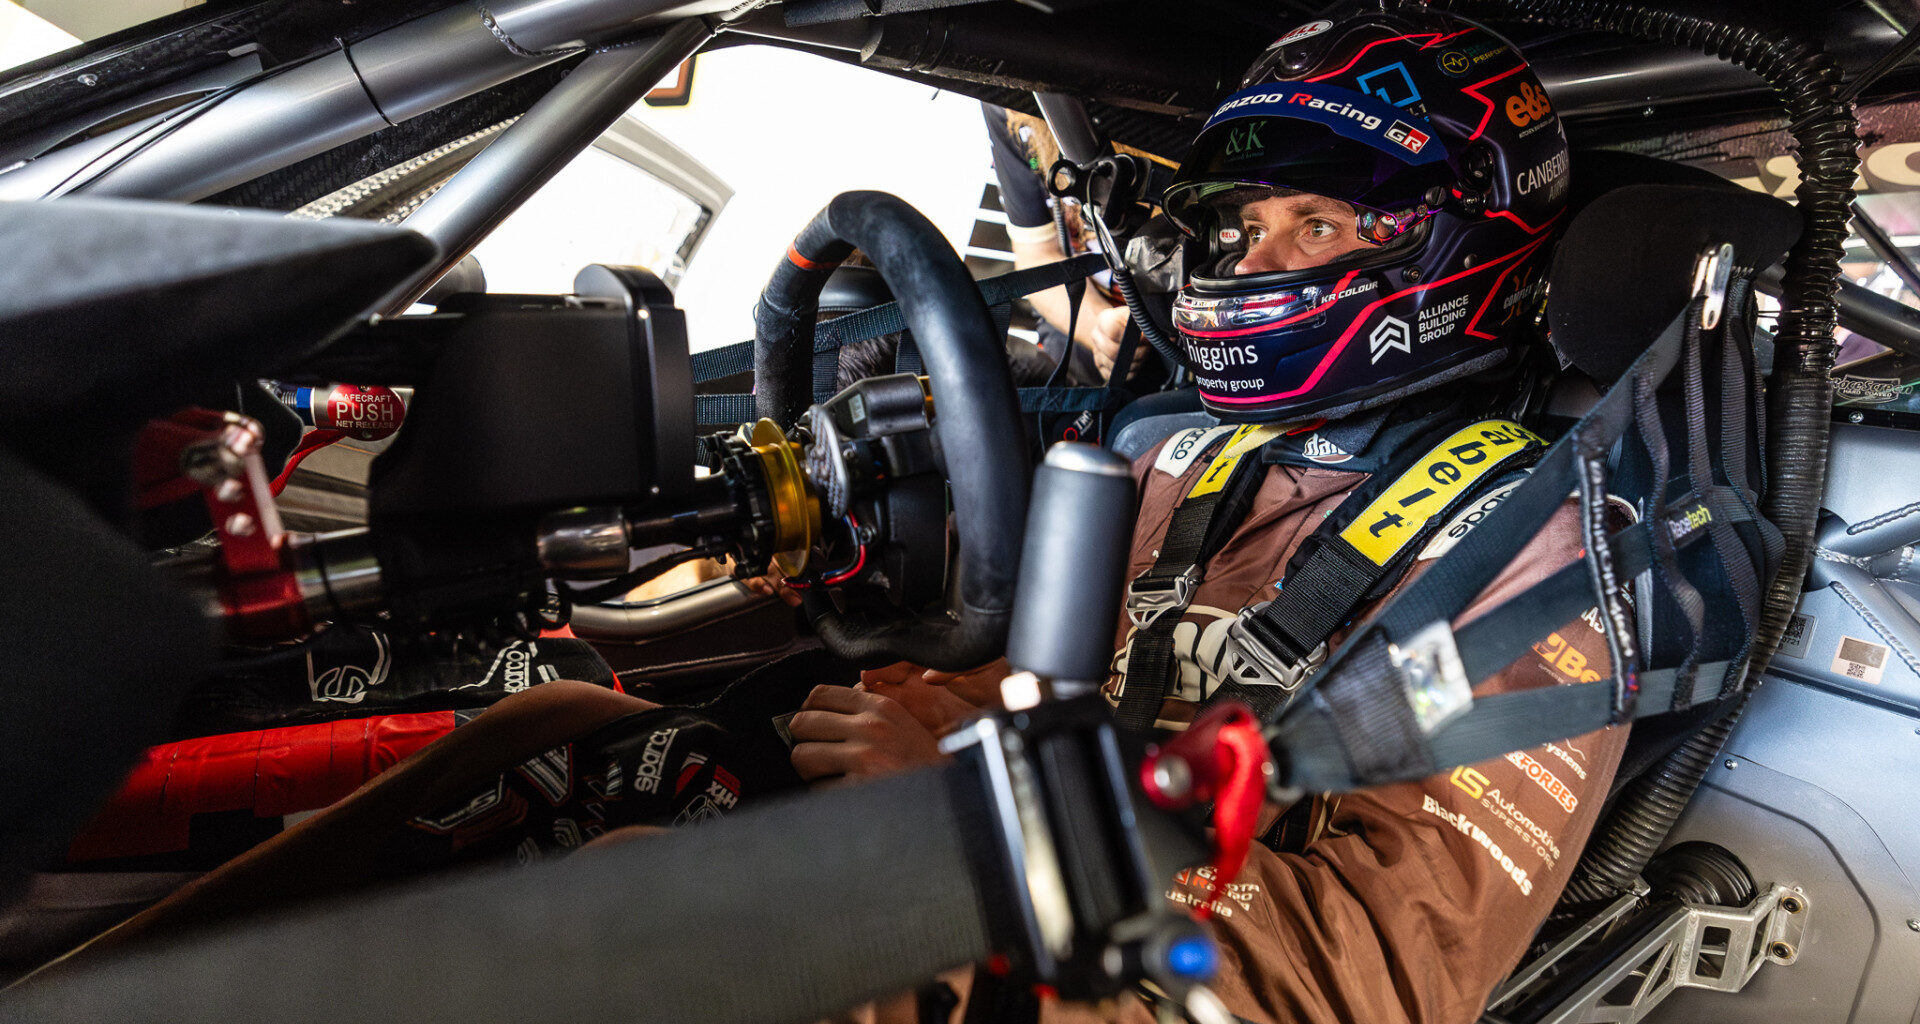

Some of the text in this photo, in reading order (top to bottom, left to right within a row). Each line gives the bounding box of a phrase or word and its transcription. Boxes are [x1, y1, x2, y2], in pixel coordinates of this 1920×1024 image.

[1214, 92, 1383, 132] GAZOO Racing
[1387, 128, 1423, 152] GR
[1221, 231, 1236, 239] BELL
[1321, 280, 1379, 304] KR COLOUR
[1418, 294, 1469, 322] ALLIANCE
[1419, 307, 1467, 334] BUILDING
[1419, 323, 1456, 345] GROUP
[1187, 337, 1259, 371] higgins
[1230, 377, 1265, 393] group
[336, 401, 394, 421] PUSH
[336, 419, 354, 428] NET
[1481, 798, 1556, 870] SUPERSTORE
[1486, 788, 1561, 860] Automotive
